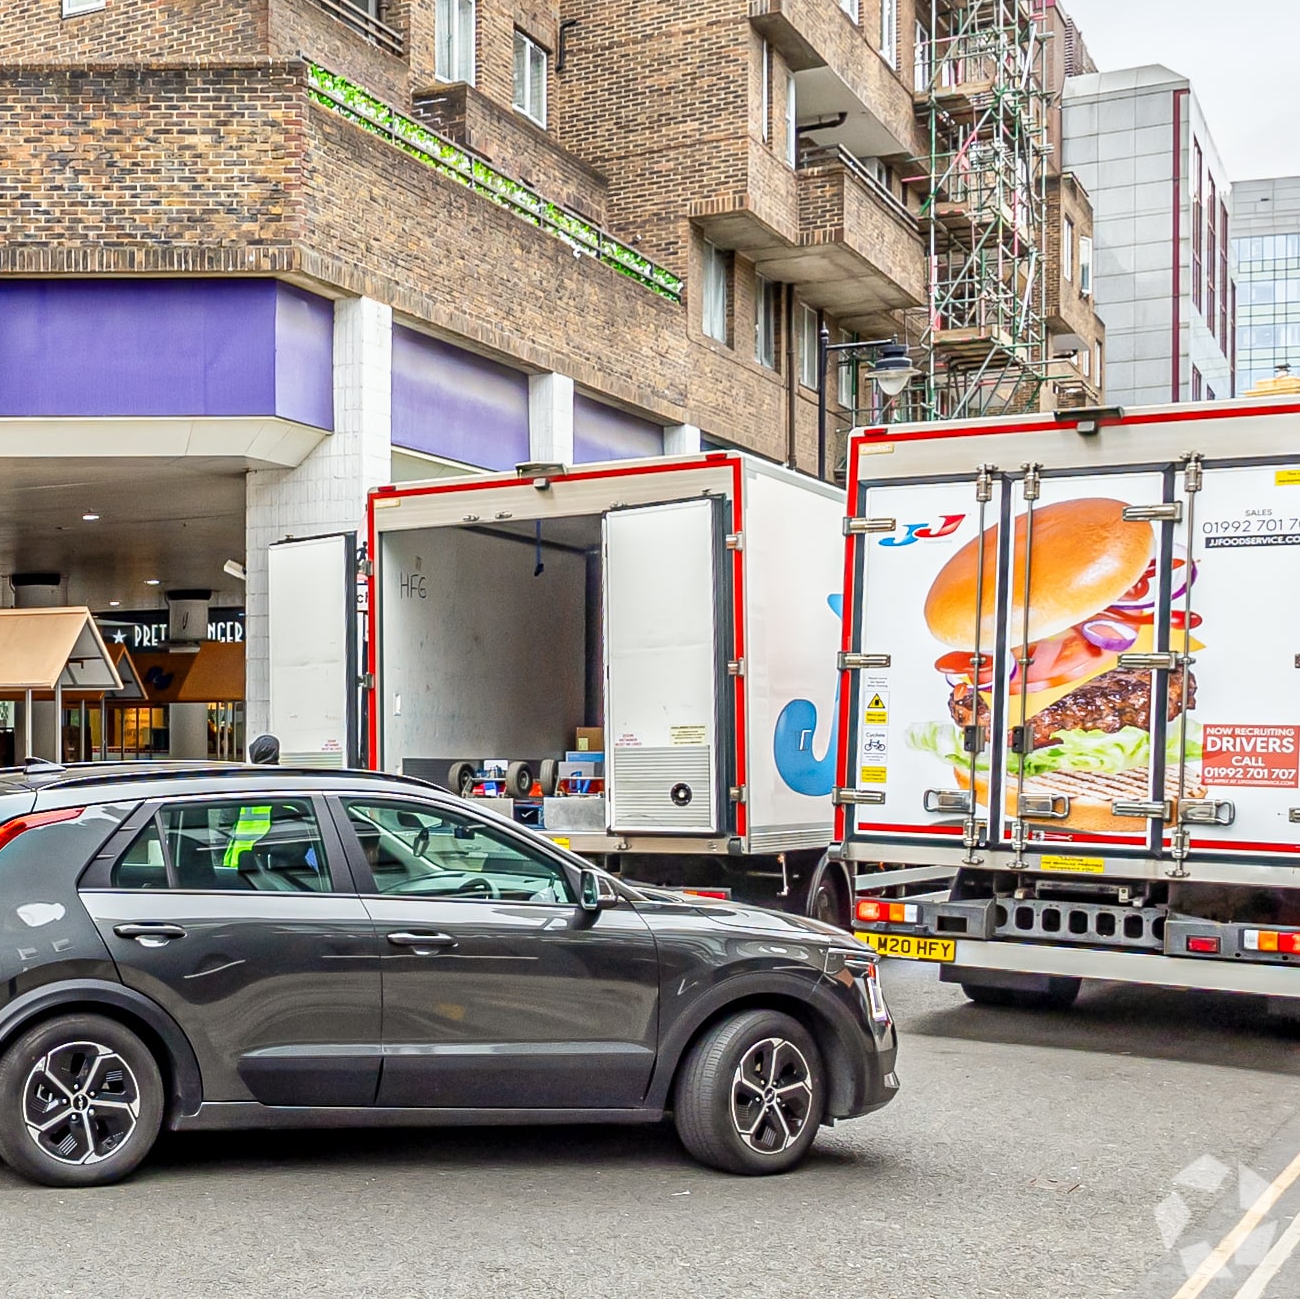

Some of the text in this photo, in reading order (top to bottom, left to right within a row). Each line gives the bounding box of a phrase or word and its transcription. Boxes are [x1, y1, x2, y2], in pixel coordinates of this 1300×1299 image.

[1244, 508, 1273, 517] SALES
[1202, 518, 1300, 534] 01992 701 7
[1208, 535, 1300, 547] JJFOODSERVICE.CO
[134, 621, 244, 647] PRET NGER
[1206, 727, 1295, 736] NOW RECRUITING
[1206, 736, 1295, 753] DRIVERS
[1231, 755, 1265, 767] CALL
[1204, 766, 1297, 780] 01992 701 707
[916, 940, 952, 958] HFY
